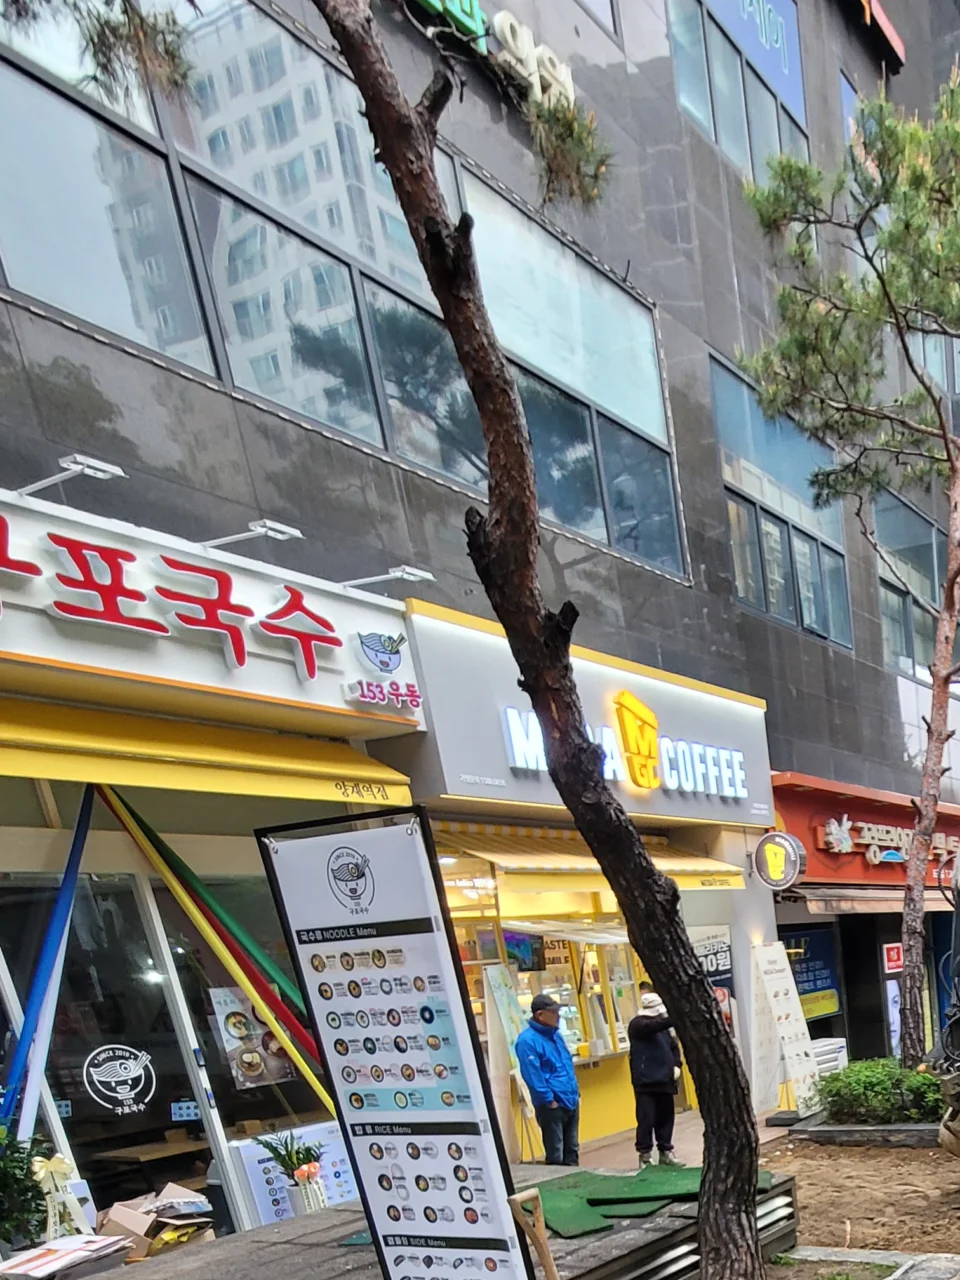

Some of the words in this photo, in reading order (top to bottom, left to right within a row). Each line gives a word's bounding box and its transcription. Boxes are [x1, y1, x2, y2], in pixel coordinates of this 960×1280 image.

[0, 514, 343, 680] 포국수
[356, 680, 387, 703] 153
[387, 680, 423, 709] 우동
[504, 705, 627, 783] MA
[659, 735, 749, 799] COFFEE
[323, 927, 356, 940] NOODLE
[356, 926, 377, 936] Menu
[97, 1050, 114, 1062] SINCE
[115, 1049, 130, 1058] 2019
[115, 1103, 146, 1116] 구포국수
[374, 1125, 392, 1134] RICE
[392, 1125, 412, 1134] Menu
[427, 1238, 447, 1247] Menu
